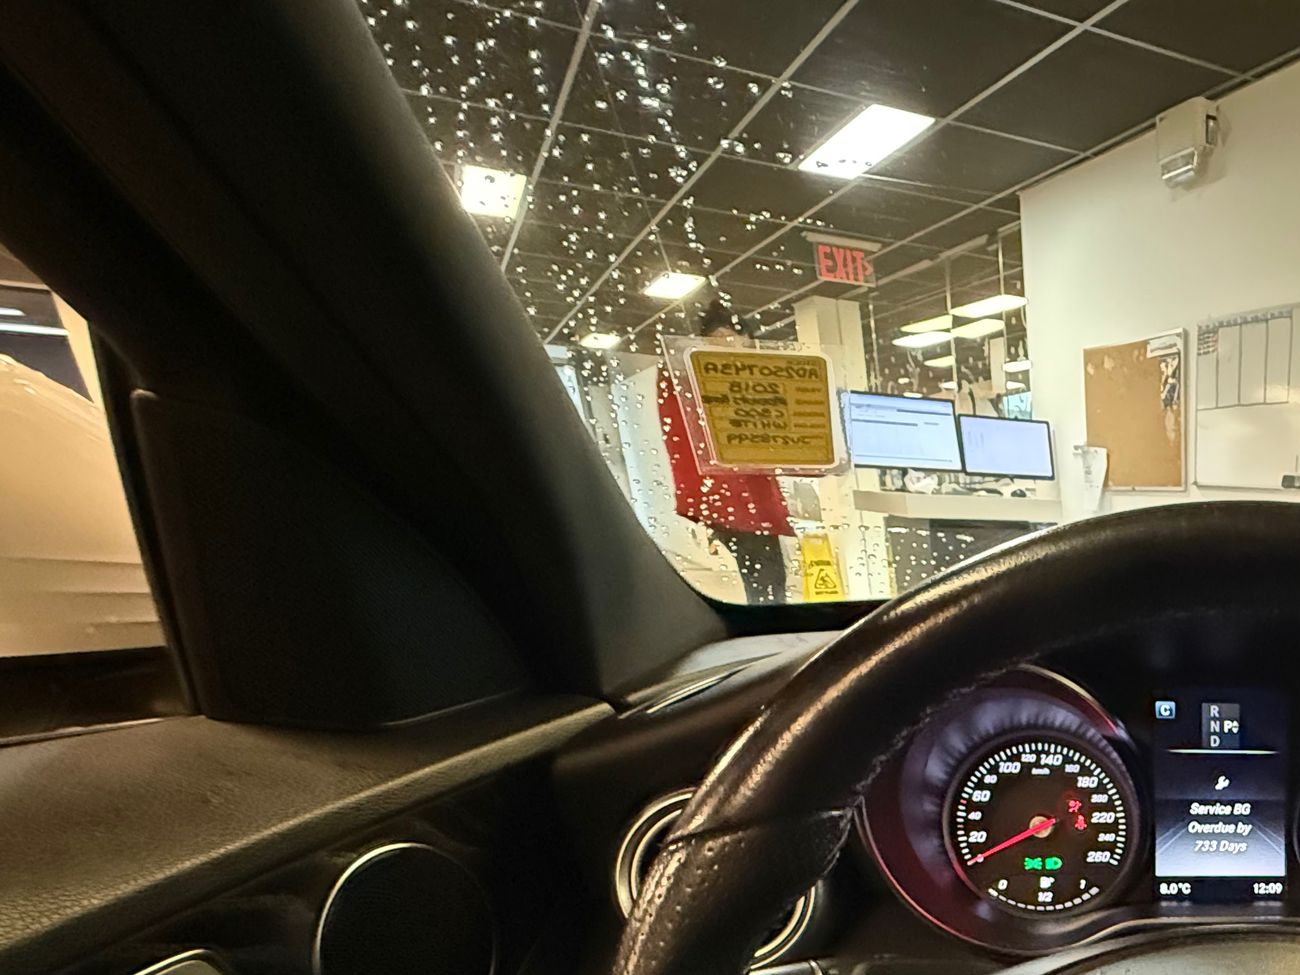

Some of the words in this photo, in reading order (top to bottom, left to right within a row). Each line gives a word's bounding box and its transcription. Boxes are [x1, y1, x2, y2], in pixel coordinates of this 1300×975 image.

[817, 244, 865, 286] EXIT
[1160, 705, 1170, 716] C
[1210, 705, 1219, 718] R
[1210, 720, 1220, 733] N
[1223, 720, 1232, 733] P
[1210, 735, 1220, 747] D
[1040, 754, 1063, 766] 140
[998, 761, 1021, 774] 100
[1076, 776, 1099, 788] 180
[971, 790, 991, 802] 60
[1189, 803, 1232, 816] Service
[1233, 803, 1251, 816] BG
[967, 811, 983, 821] 40
[1091, 812, 1115, 824] 220
[1188, 821, 1235, 834] Overdue
[1236, 821, 1252, 836] by
[968, 831, 987, 843] 20
[1193, 840, 1218, 852] 733
[1219, 841, 1248, 854] Days
[1086, 851, 1111, 863] 260
[998, 878, 1008, 890] 0
[1079, 878, 1086, 890] 1
[1253, 882, 1283, 895] 12:09
[1037, 891, 1054, 903] 1/2
